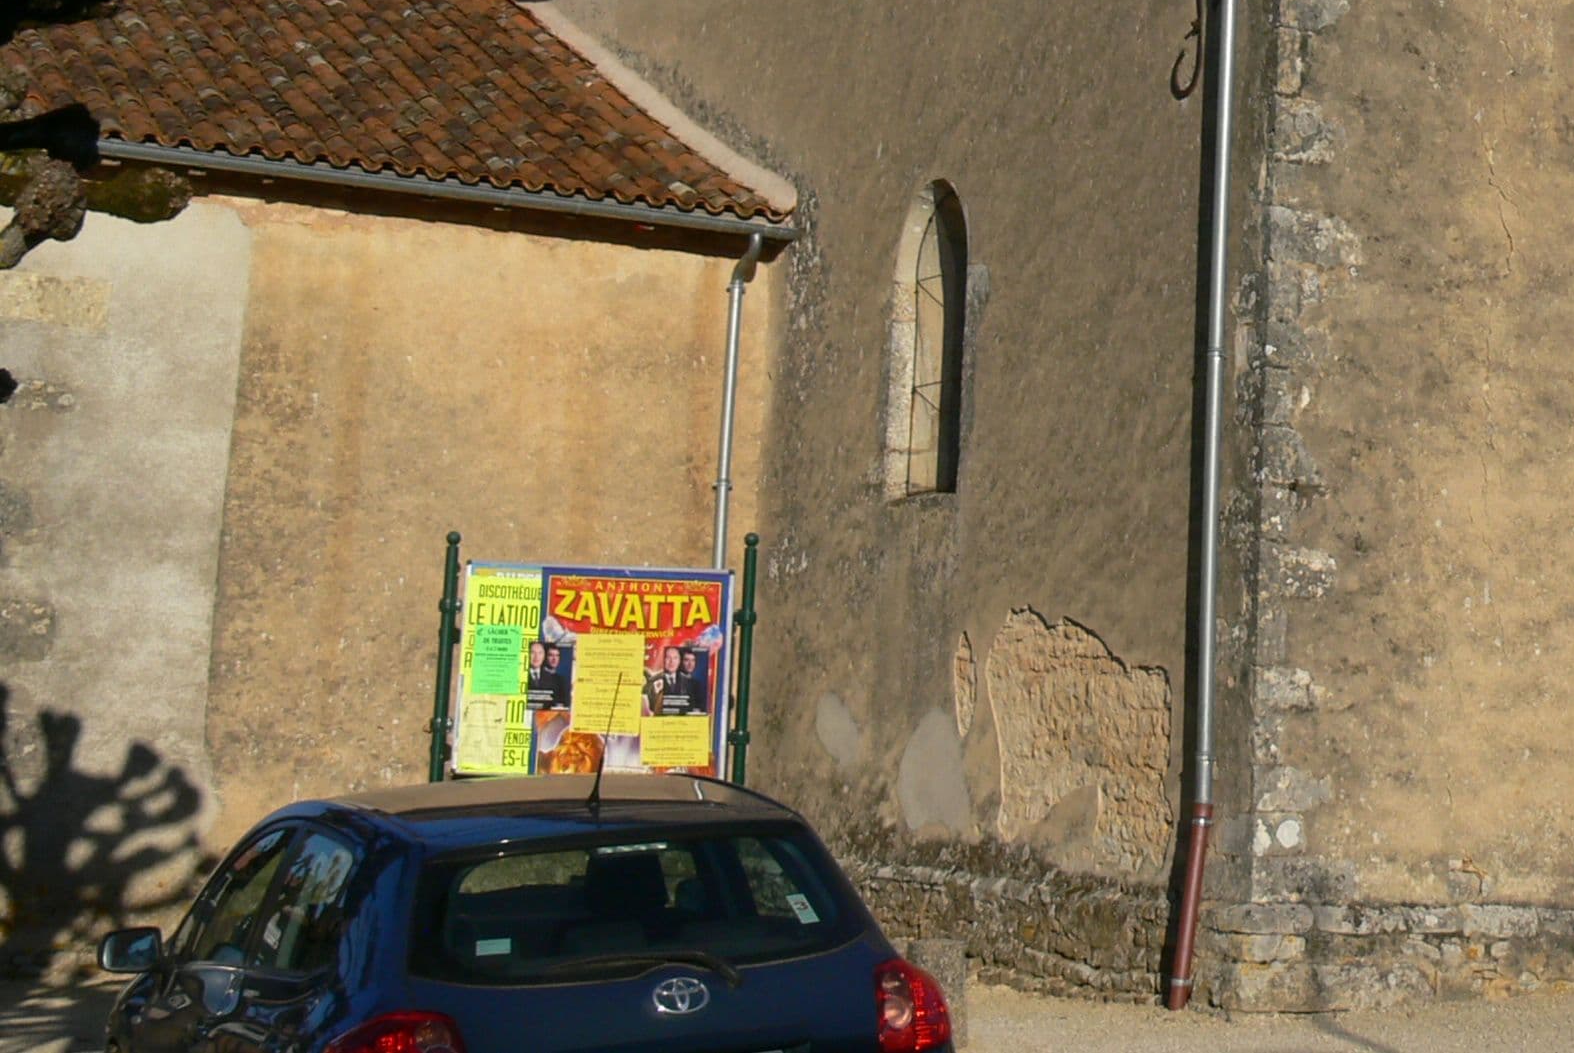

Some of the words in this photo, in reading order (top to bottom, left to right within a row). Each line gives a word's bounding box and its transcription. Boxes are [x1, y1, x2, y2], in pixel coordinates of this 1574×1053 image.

[594, 580, 676, 593] ANTHONY
[468, 602, 486, 626] LE
[490, 603, 540, 630] LATINO
[554, 588, 713, 630] ZAVATTA
